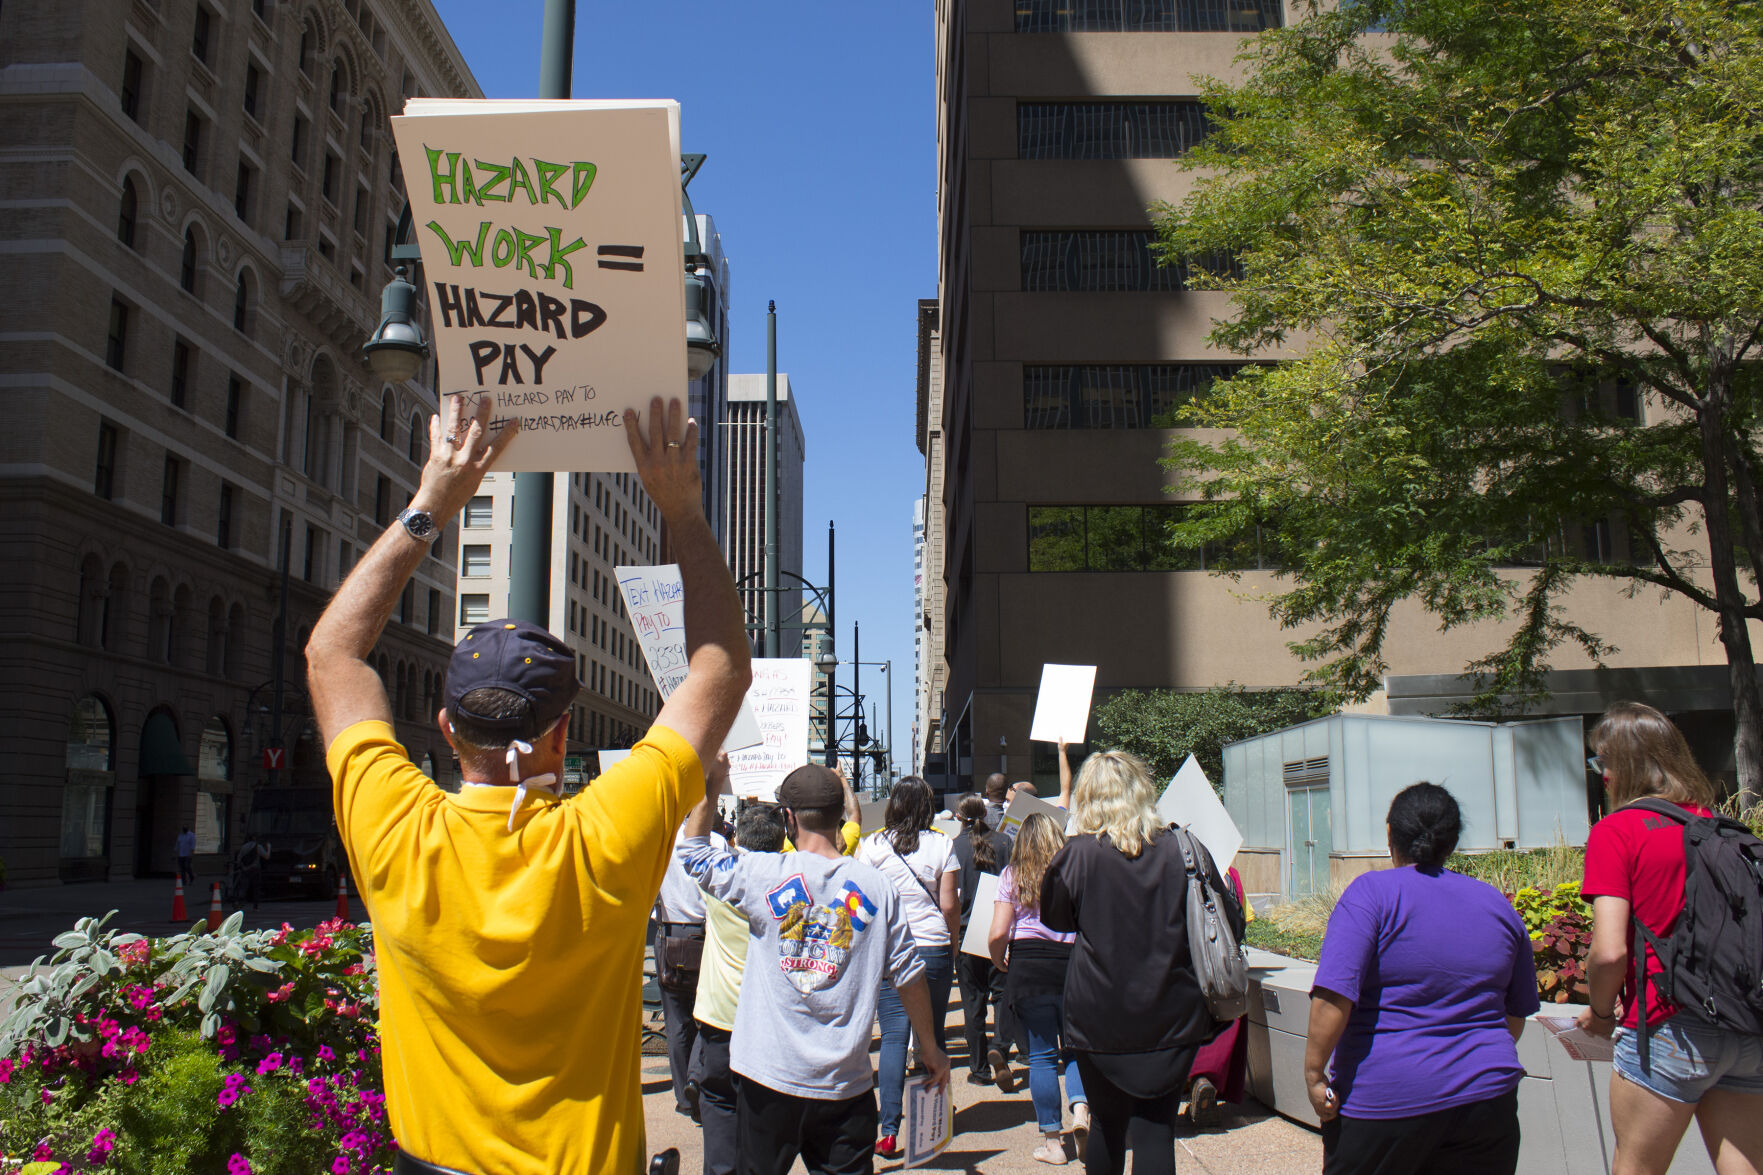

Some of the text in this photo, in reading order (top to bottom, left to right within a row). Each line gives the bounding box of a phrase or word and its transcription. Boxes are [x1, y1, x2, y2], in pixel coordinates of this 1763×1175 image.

[423, 143, 597, 211] HAZARD
[425, 220, 587, 289] WORK
[434, 281, 607, 340] HAZARD
[469, 340, 557, 386] PAY
[497, 391, 549, 407] HAZARD
[555, 386, 577, 405] PAY
[579, 386, 596, 401] TO
[267, 749, 282, 767] Y
[786, 957, 834, 974] STRONG
